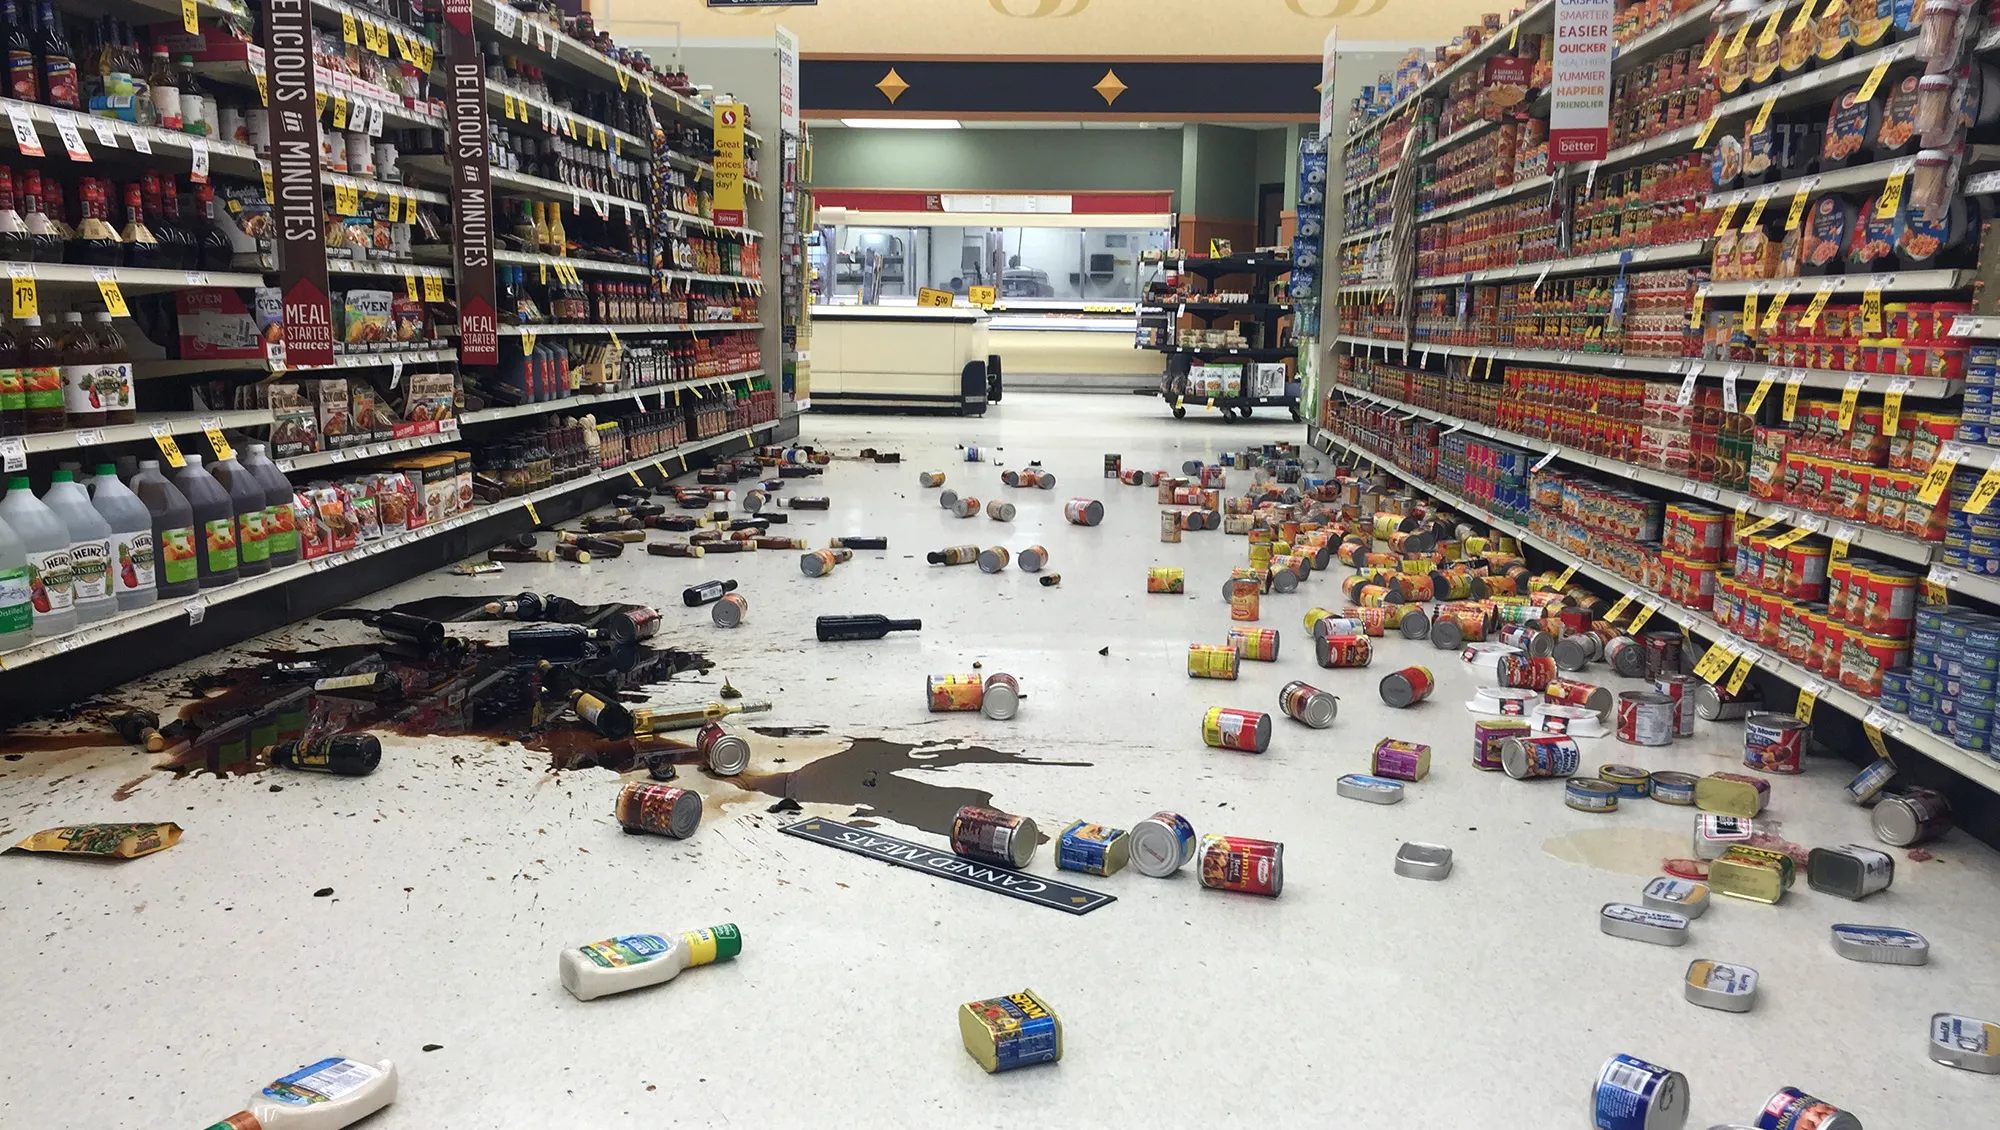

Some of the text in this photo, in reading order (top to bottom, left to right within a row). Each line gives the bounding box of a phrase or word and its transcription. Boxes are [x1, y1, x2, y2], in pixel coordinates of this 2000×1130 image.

[1560, 10, 1608, 20] SMARTER
[1559, 25, 1607, 37] EASIER
[1559, 43, 1606, 53] QUICKER
[1558, 71, 1605, 81] YUMMIER
[1556, 86, 1604, 96] HAPPIER
[1556, 101, 1604, 109] FRIENDLIER
[281, 110, 304, 132] in
[18, 125, 31, 142] 529
[65, 133, 79, 149] 529
[716, 139, 740, 149] Great
[1561, 140, 1595, 151] better
[719, 150, 733, 159] ale
[454, 65, 488, 267] DELICIOUS in MINUTES
[716, 161, 741, 171] prices
[716, 171, 738, 180] every
[279, 141, 317, 241] MINUTES
[716, 181, 732, 190] day!
[1881, 185, 1899, 208] 299
[15, 287, 34, 309] 179
[104, 289, 121, 308] 179
[186, 294, 222, 304] OVEN
[934, 295, 948, 307] 500
[285, 303, 329, 325] MEAL
[1863, 300, 1879, 322] 299
[463, 315, 495, 332] MEAL
[287, 326, 330, 340] STARTER
[463, 333, 496, 345] STARTER
[288, 341, 330, 350] sauces
[1926, 470, 1947, 492] 199
[1973, 480, 1999, 502] 125
[73, 547, 102, 560] HEINZ
[1971, 631, 1999, 642] StarKist
[1757, 726, 1780, 737] Moore
[1570, 750, 1578, 772] Dinty
[835, 832, 1047, 893] CANNED MEATS
[1233, 859, 1241, 877] Beef
[1240, 847, 1251, 888] Tamales
[1009, 993, 1048, 1019] SPAM
